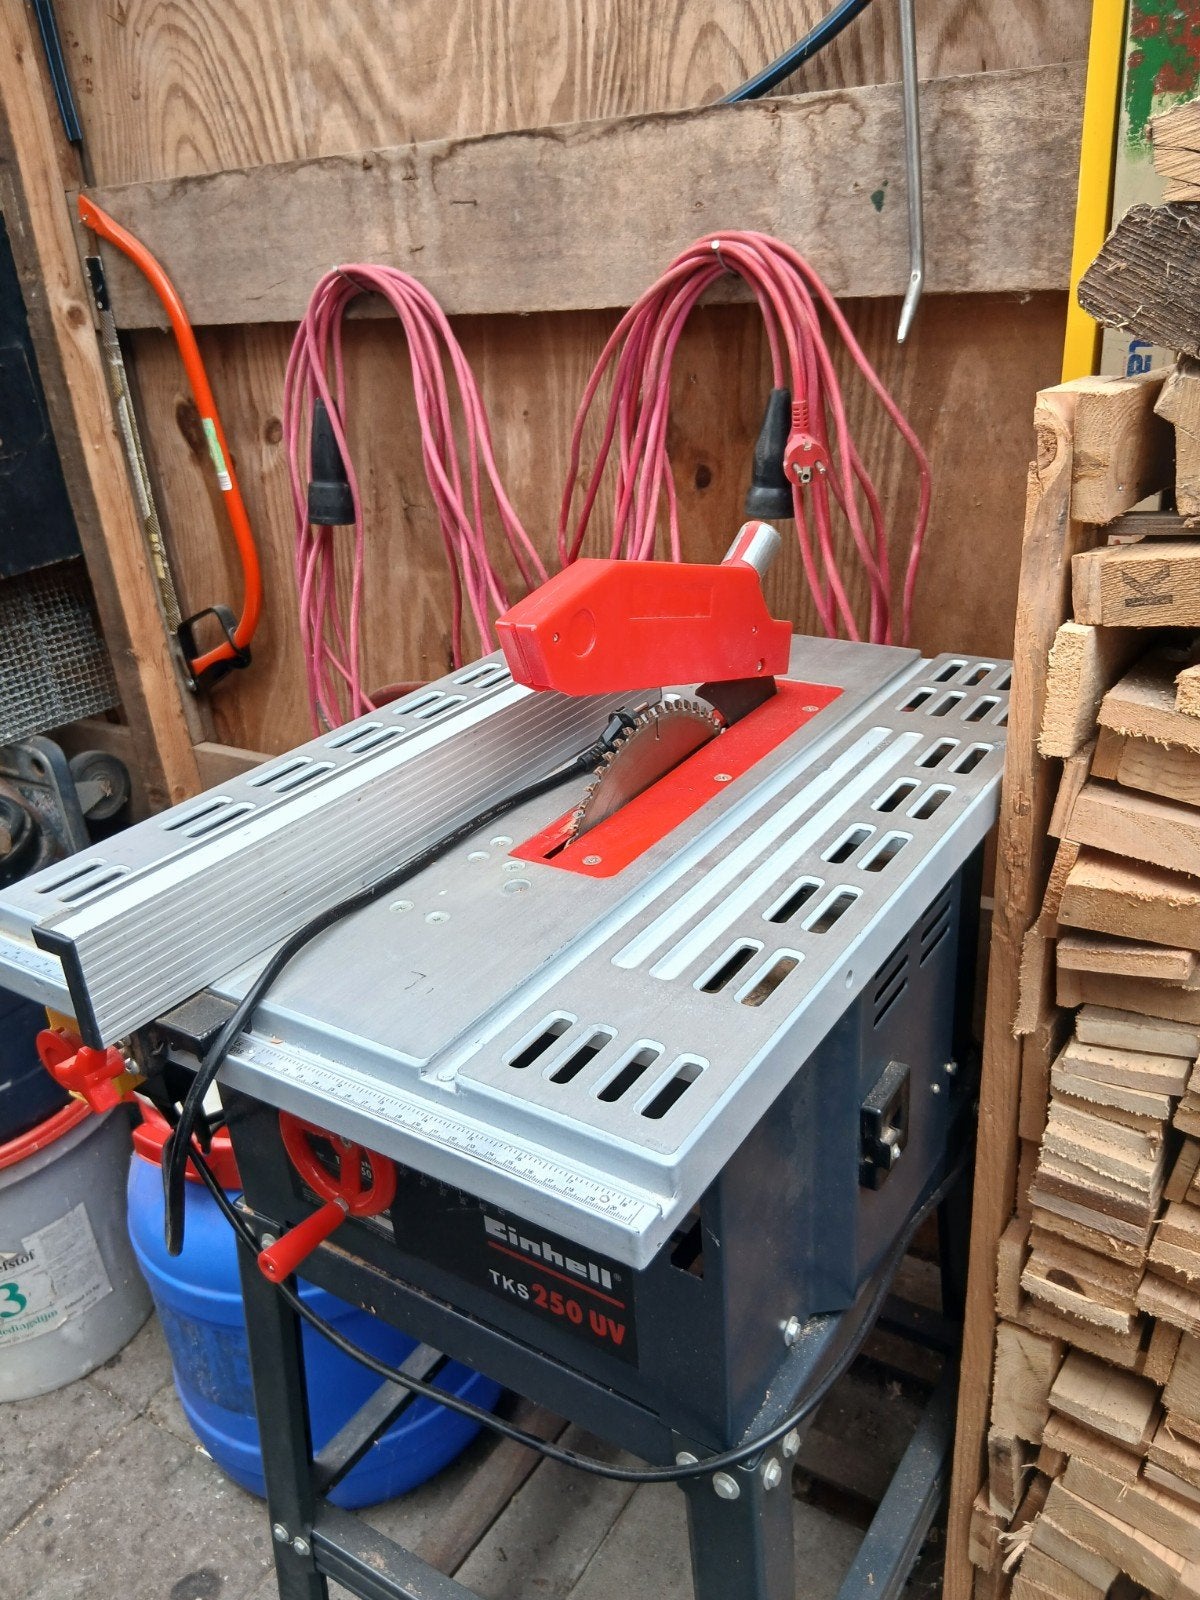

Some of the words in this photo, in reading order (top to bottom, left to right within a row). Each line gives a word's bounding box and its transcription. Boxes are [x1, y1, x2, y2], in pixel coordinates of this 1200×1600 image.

[484, 1214, 613, 1290] Einhell
[0, 1282, 28, 1318] 3
[488, 1268, 530, 1300] TKS
[532, 1283, 583, 1325] 250
[589, 1308, 626, 1346] UV
